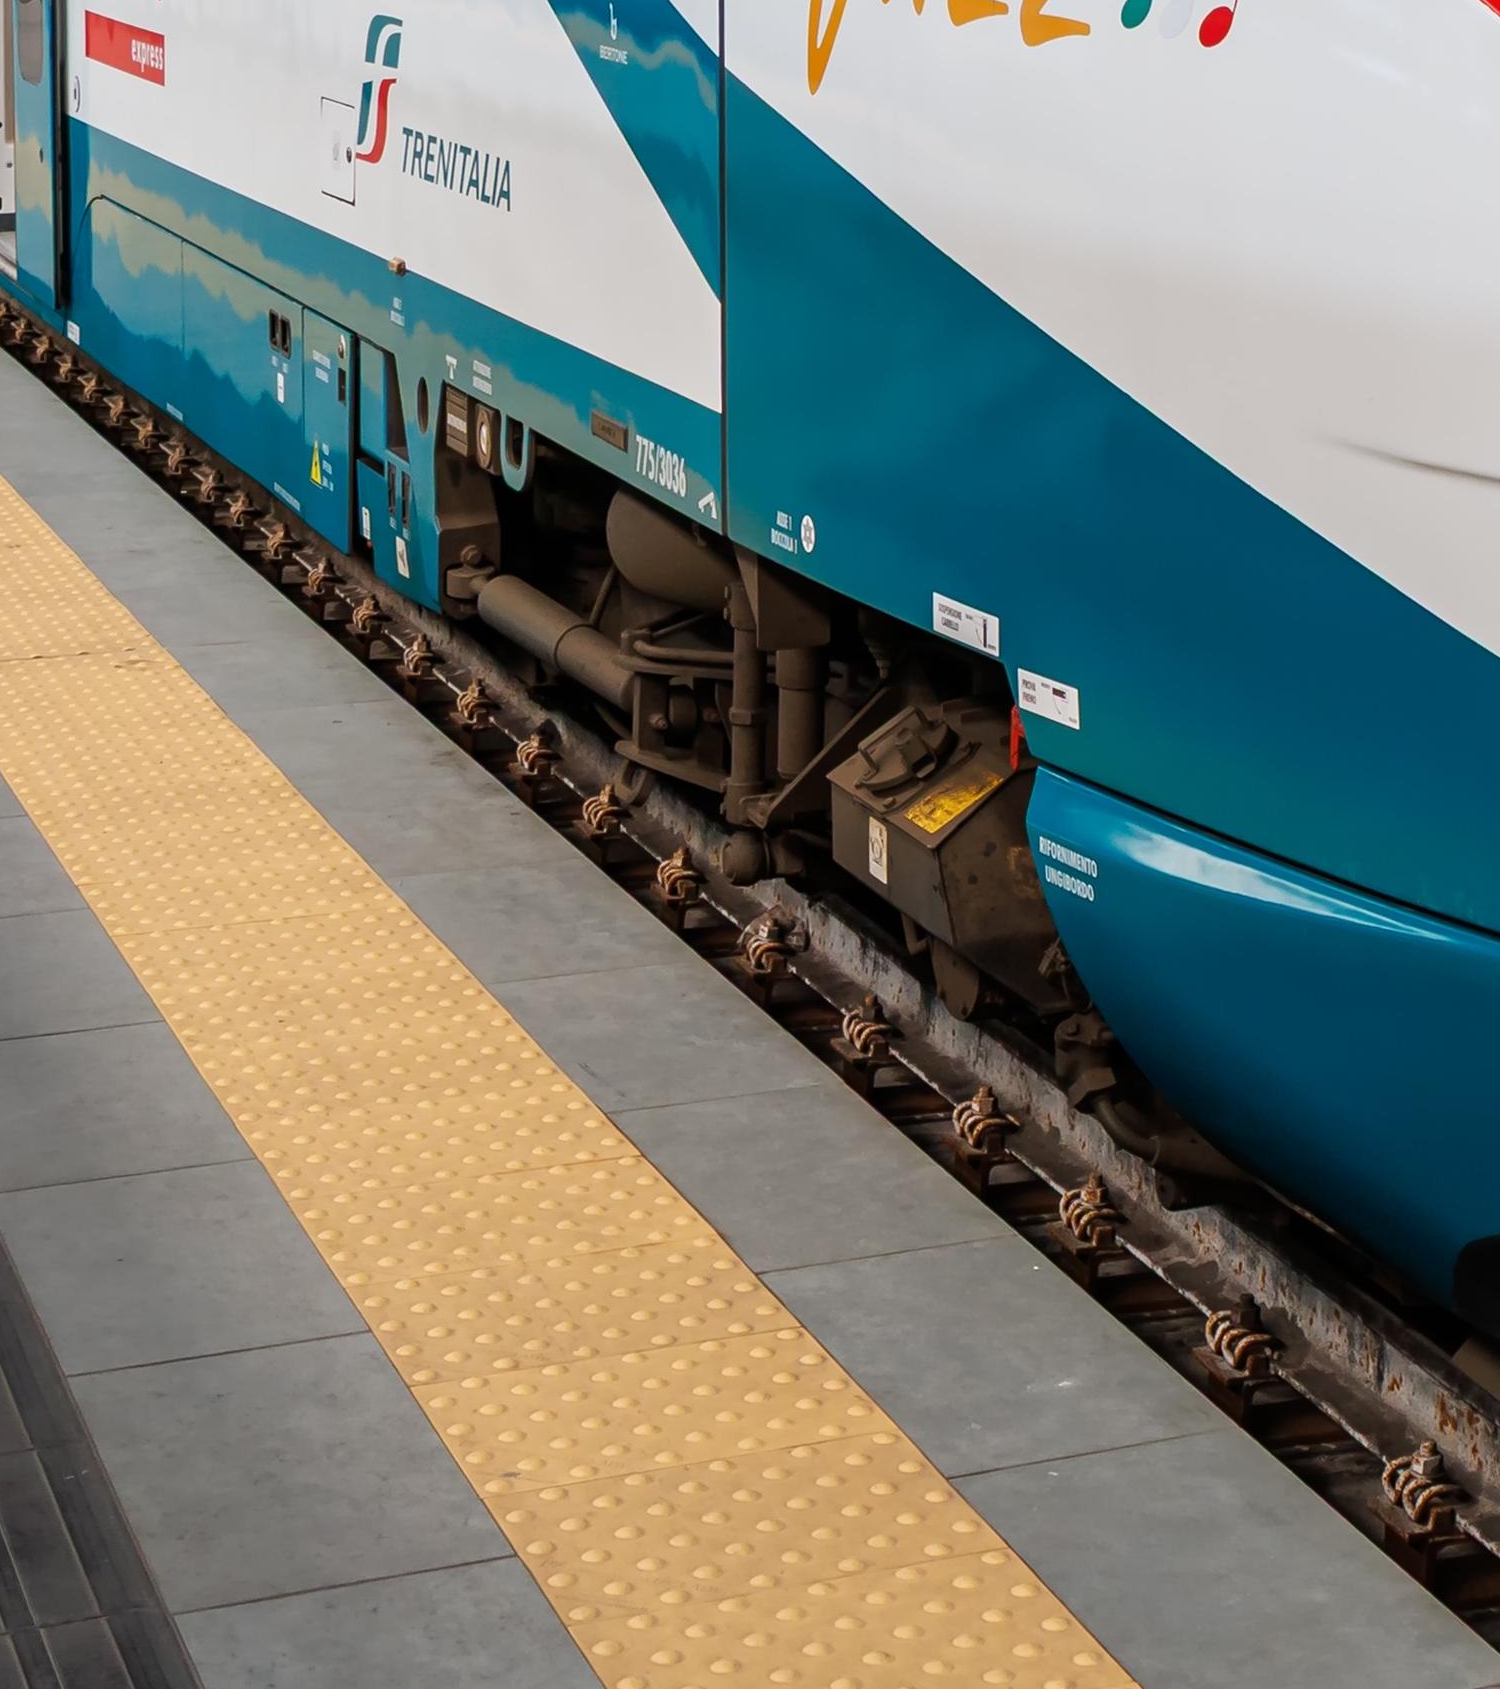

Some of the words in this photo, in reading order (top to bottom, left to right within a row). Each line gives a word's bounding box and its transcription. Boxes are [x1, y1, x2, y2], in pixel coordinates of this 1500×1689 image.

[131, 39, 164, 73] express
[402, 126, 511, 212] TRENITALIA
[636, 434, 687, 498] 775/3036
[1039, 836, 1098, 878] RIFORNIMENTO
